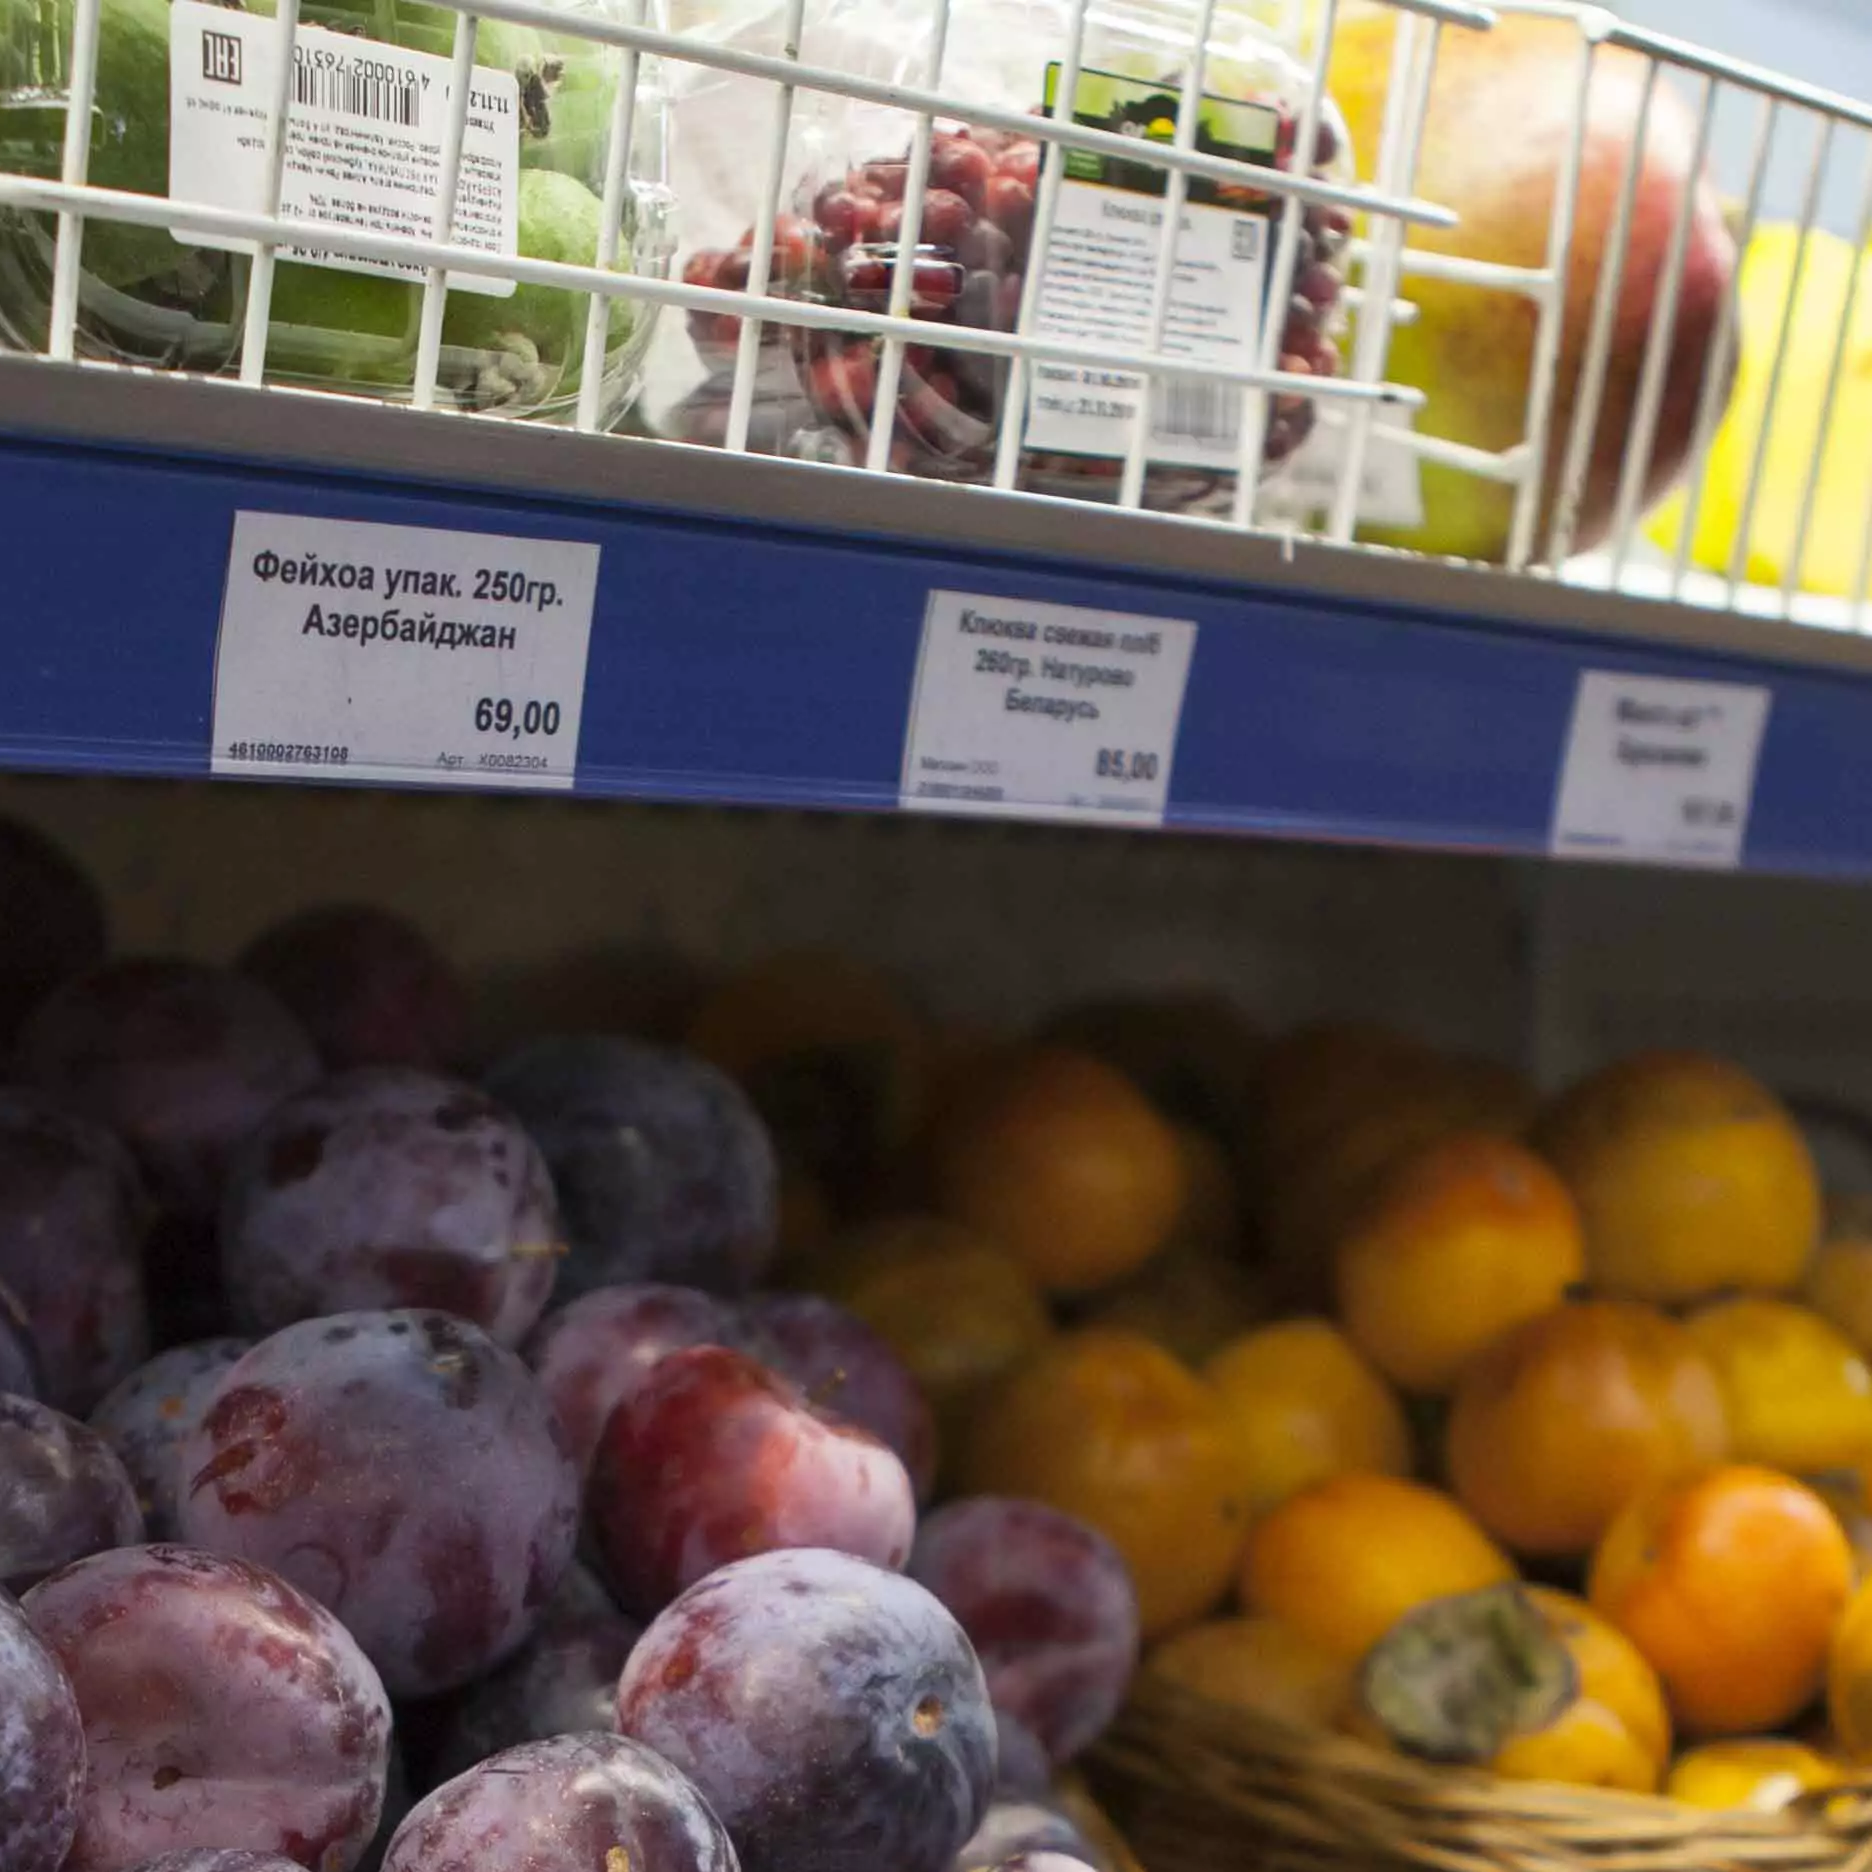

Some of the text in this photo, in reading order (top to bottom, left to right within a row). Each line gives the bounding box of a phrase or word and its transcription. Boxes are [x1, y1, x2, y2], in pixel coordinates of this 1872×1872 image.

[293, 44, 431, 91] 4 610002 76310
[252, 549, 564, 612] Фейхоа упак. 250гр.
[301, 604, 517, 651] Азербайджан
[475, 697, 561, 740] 69,00
[1004, 687, 1101, 722] Беларусь
